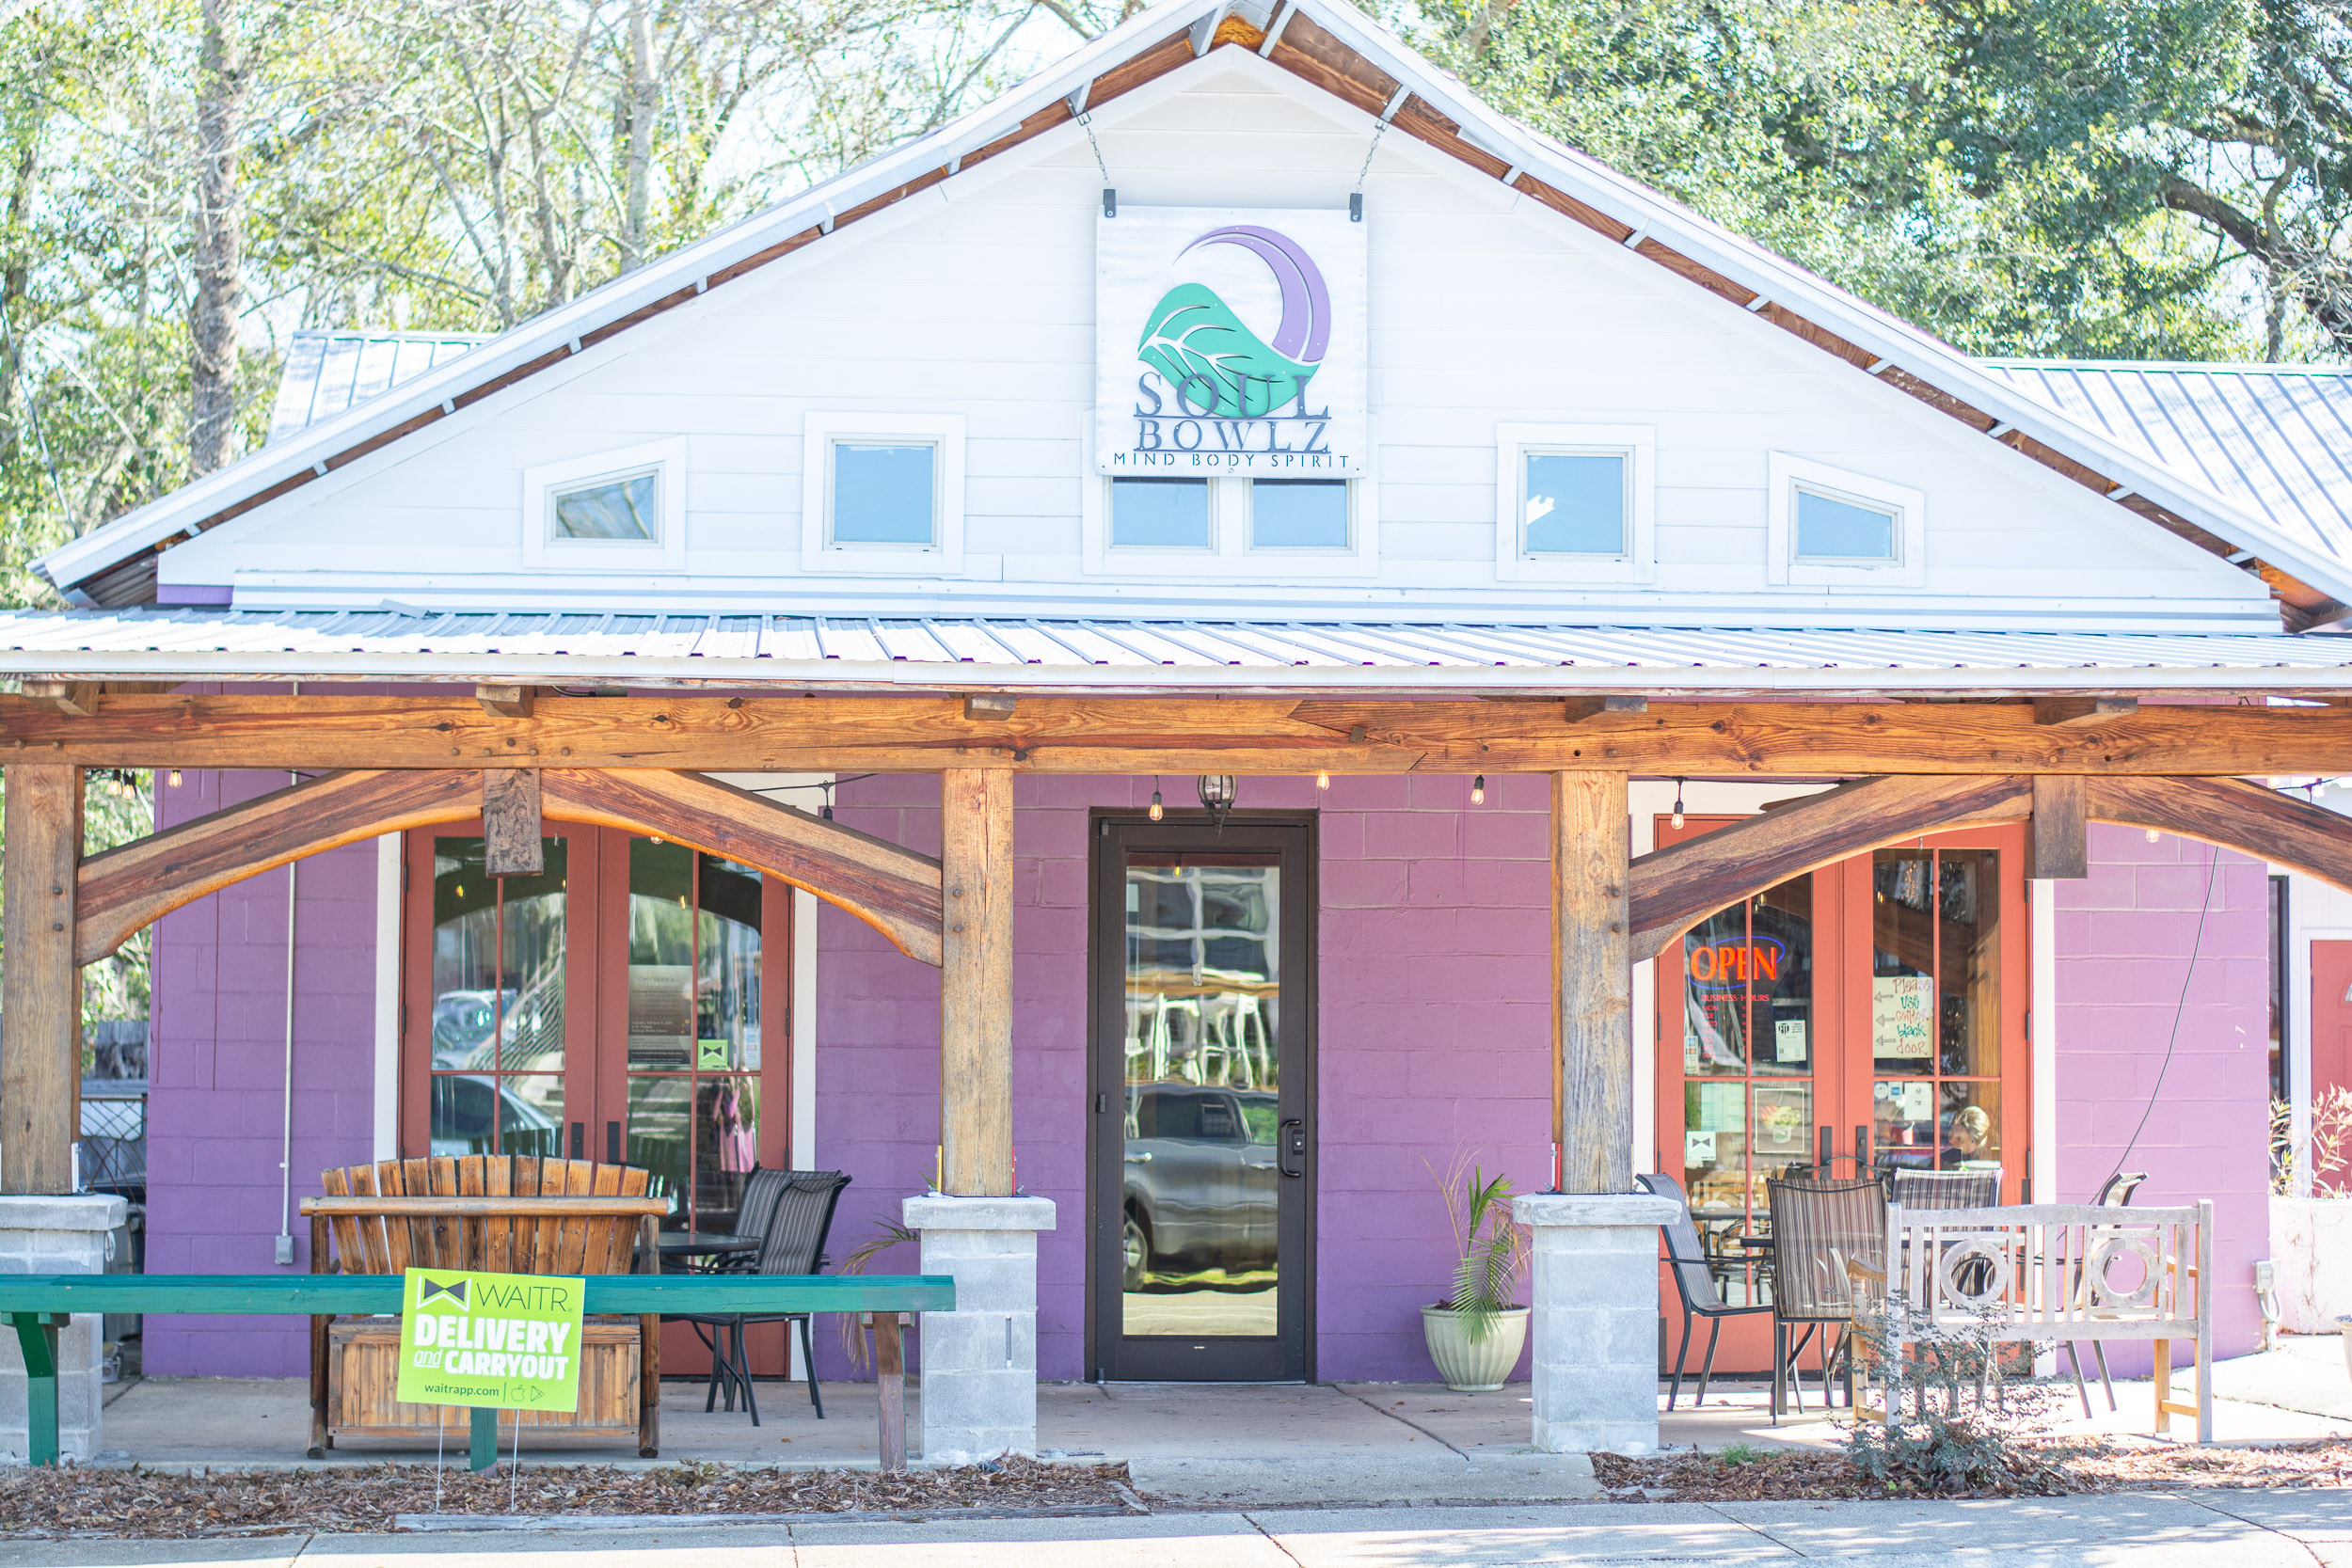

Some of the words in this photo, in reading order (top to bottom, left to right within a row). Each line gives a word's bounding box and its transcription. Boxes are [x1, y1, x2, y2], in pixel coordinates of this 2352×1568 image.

[1136, 371, 1328, 418] SOUL
[1136, 420, 1328, 452] BOWLZ
[1114, 452, 1175, 466] MIND
[1192, 453, 1255, 467] BODY
[1270, 454, 1349, 467] SPIRIT
[1691, 946, 1776, 981] OPEN
[1701, 993, 1738, 1002] BUSINESS
[1893, 977, 1931, 994] Please
[476, 1282, 568, 1312] WAITR
[414, 1313, 571, 1354] DELIVERY
[414, 1349, 443, 1366] and
[444, 1350, 569, 1381] CARRYOUT
[424, 1383, 500, 1397] waitrapp.com
